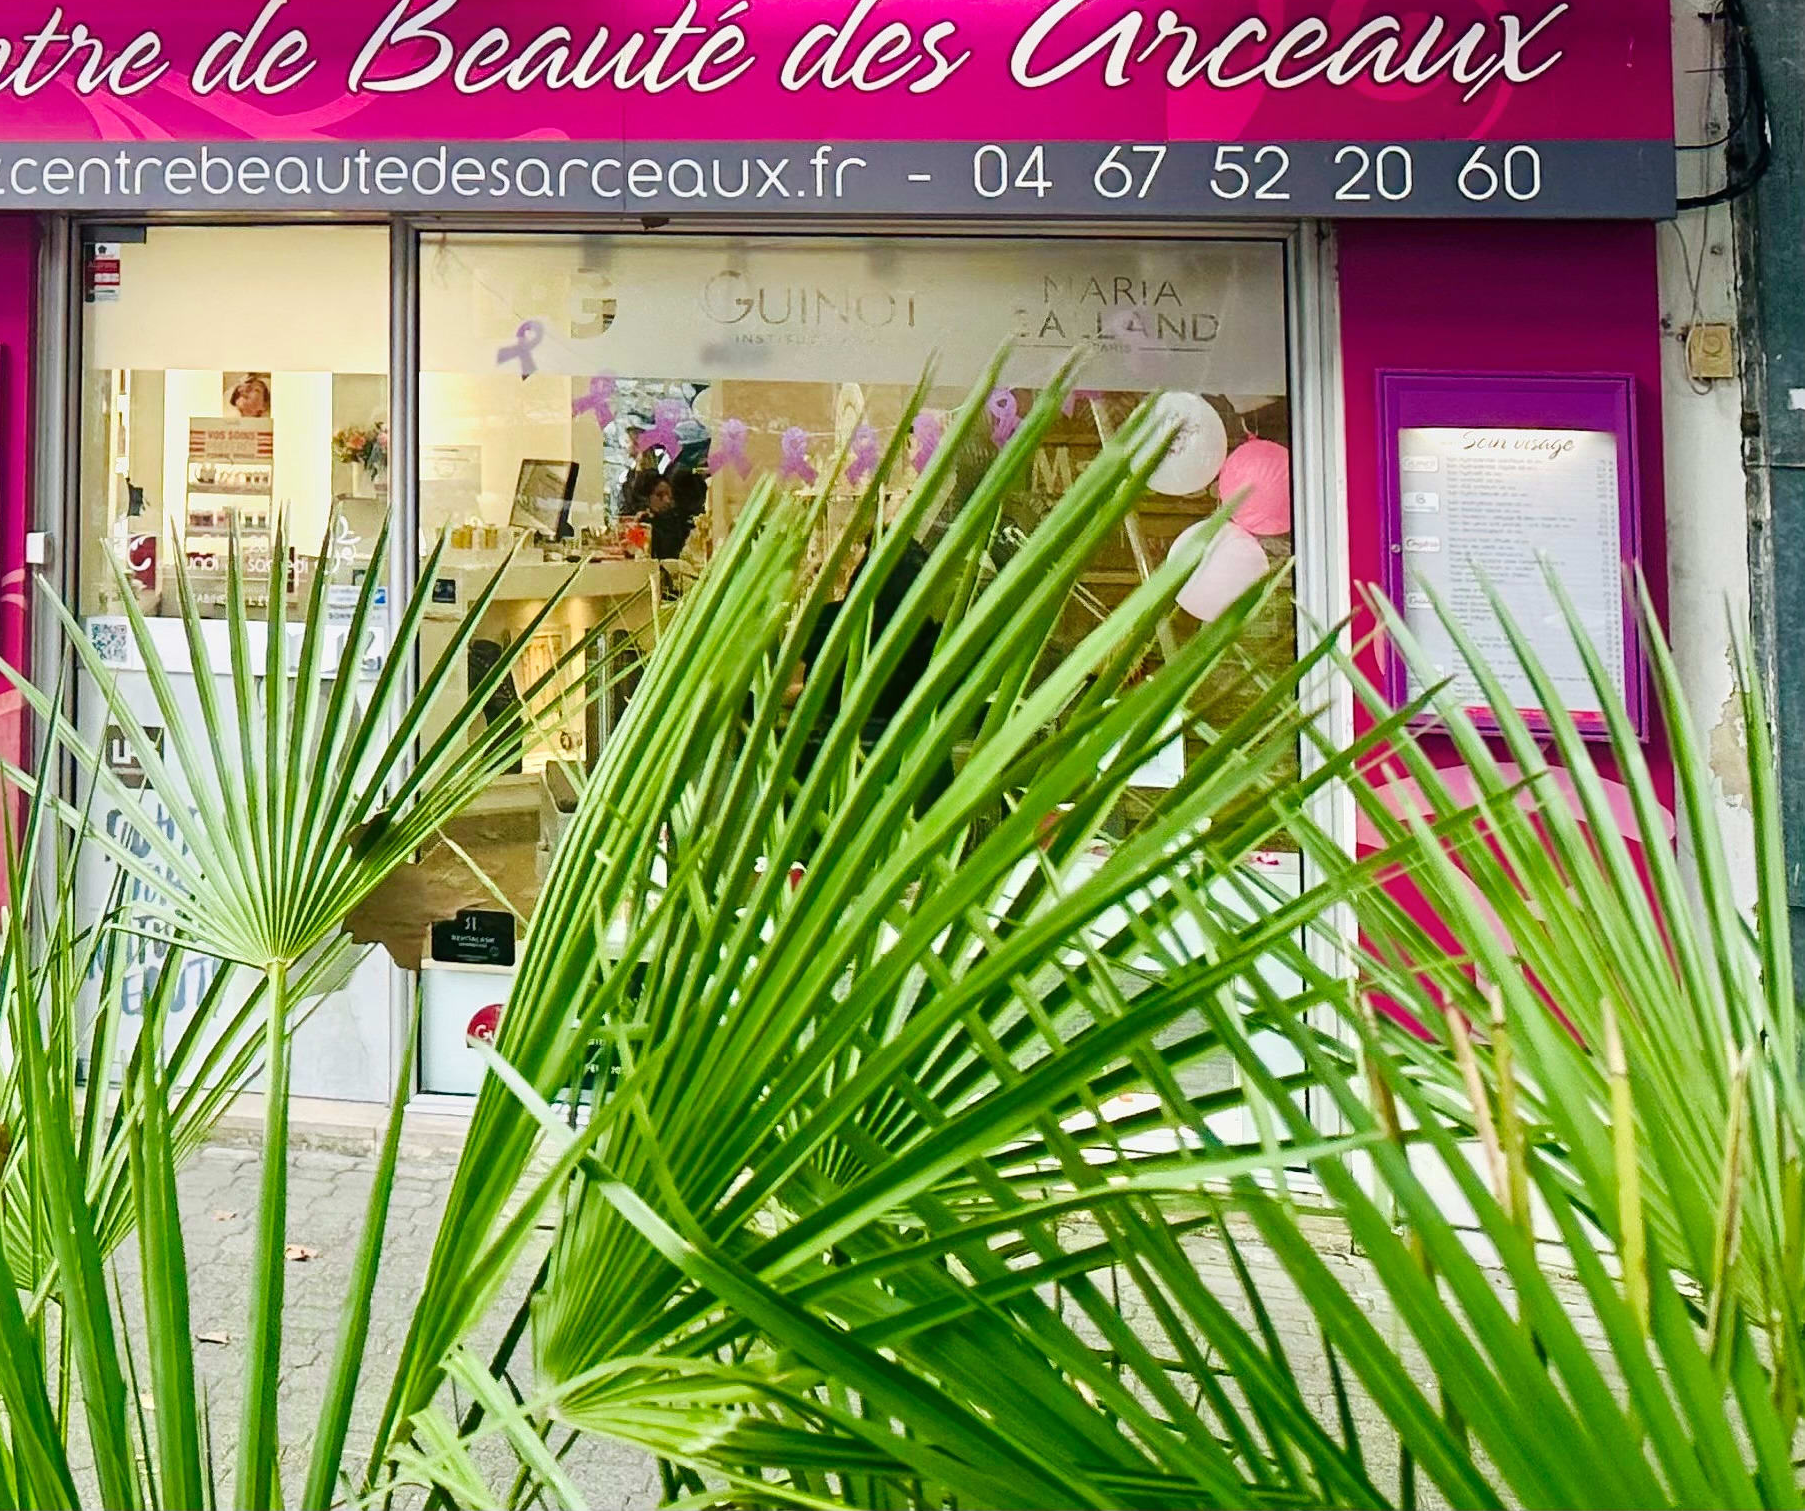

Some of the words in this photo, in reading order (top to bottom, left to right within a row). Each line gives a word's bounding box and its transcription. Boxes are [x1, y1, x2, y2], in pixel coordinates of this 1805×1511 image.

[973, 144, 1053, 199] 04
[1094, 144, 1168, 199] 67
[1209, 144, 1290, 200] 52
[1334, 145, 1413, 201] 20
[1457, 145, 1542, 201] 60
[1014, 309, 1220, 341] ALAND
[1462, 431, 1506, 451] Soin
[1514, 438, 1576, 460] visage
